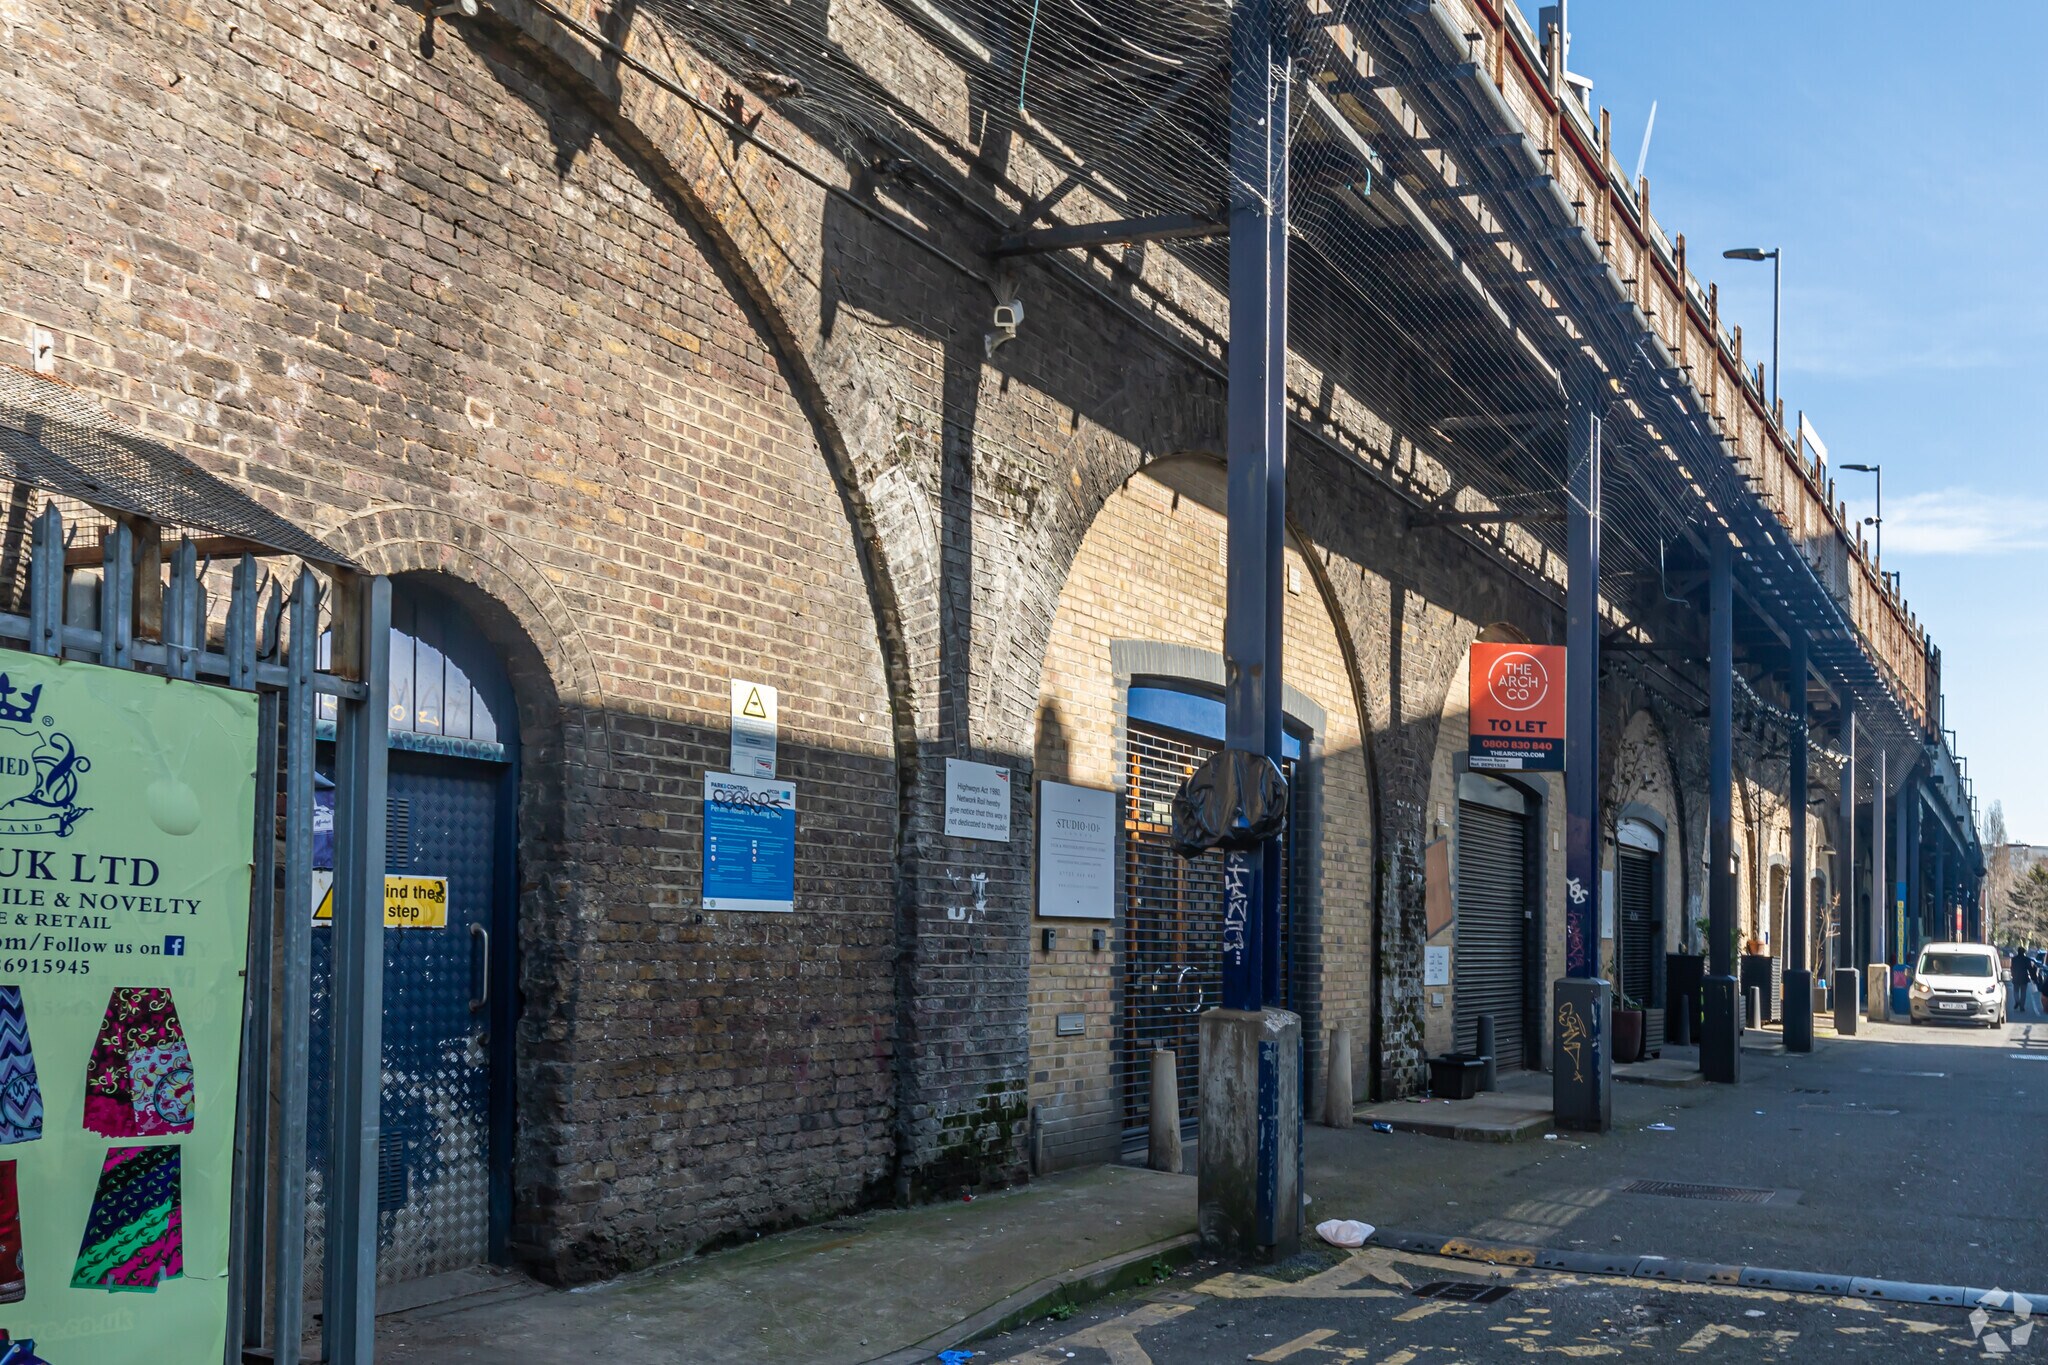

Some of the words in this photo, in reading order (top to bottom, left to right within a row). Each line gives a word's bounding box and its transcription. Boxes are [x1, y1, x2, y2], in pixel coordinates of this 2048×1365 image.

[1504, 662, 1532, 676] THE
[1498, 674, 1538, 689] ARCH
[1506, 688, 1529, 701] CO
[1488, 718, 1511, 732] TO
[1515, 720, 1547, 734] LET
[1482, 740, 1509, 749] 0800
[1511, 741, 1530, 750] 830
[1532, 742, 1552, 751] 840
[1490, 750, 1545, 758] THEARCHCO.COM
[957, 782, 980, 794] Highways
[956, 794, 976, 804] Network
[977, 797, 985, 805] Rail
[986, 799, 1001, 809] hereby
[949, 806, 960, 815] give
[961, 808, 975, 816] notice
[976, 809, 985, 817] that
[994, 813, 1003, 821] way
[0, 823, 43, 833] AND
[957, 818, 981, 828] dedicated
[981, 821, 987, 829] to
[0, 847, 57, 881] UK
[70, 853, 160, 887] LTD
[413, 885, 435, 899] the
[54, 892, 71, 908] &
[79, 893, 202, 915] NOVELTY
[388, 904, 419, 921] step
[15, 913, 28, 926] &
[35, 913, 112, 930] RETAIL
[0, 933, 108, 954] m/Follow
[115, 943, 132, 955] us
[140, 944, 161, 955] on
[0, 957, 90, 975] 6915945
